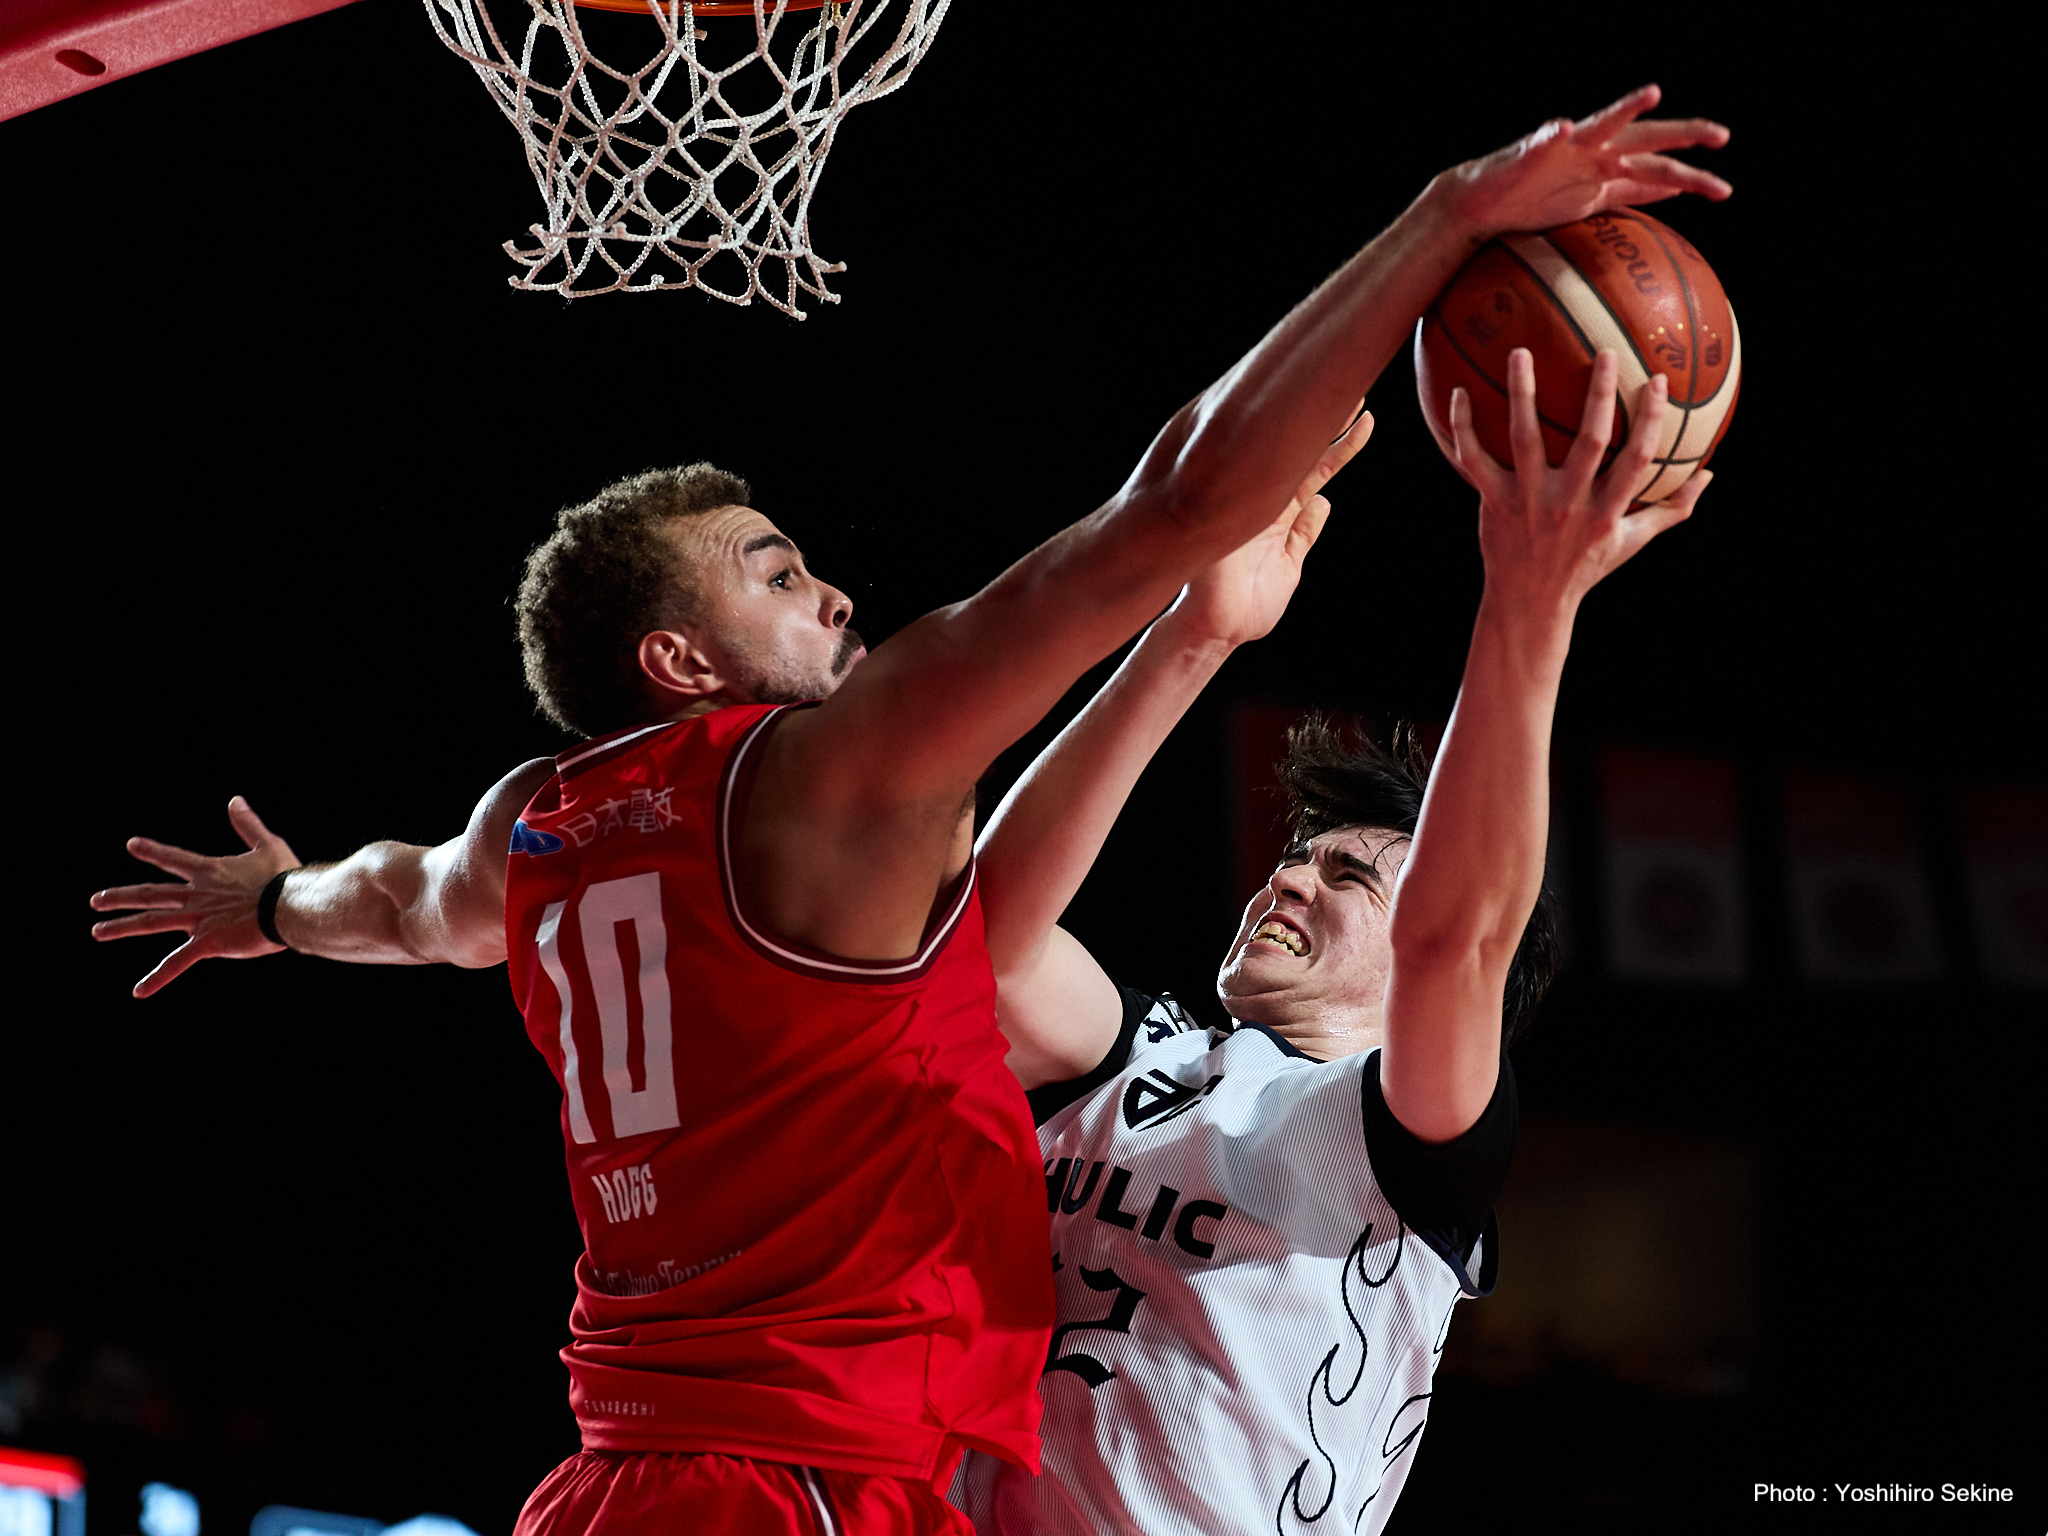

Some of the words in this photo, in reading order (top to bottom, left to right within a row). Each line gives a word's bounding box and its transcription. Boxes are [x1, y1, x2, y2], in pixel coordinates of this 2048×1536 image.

[1583, 214, 1661, 295] molte
[534, 871, 681, 1144] 10
[591, 1163, 658, 1224] HOGG
[1042, 1251, 1148, 1389] 2
